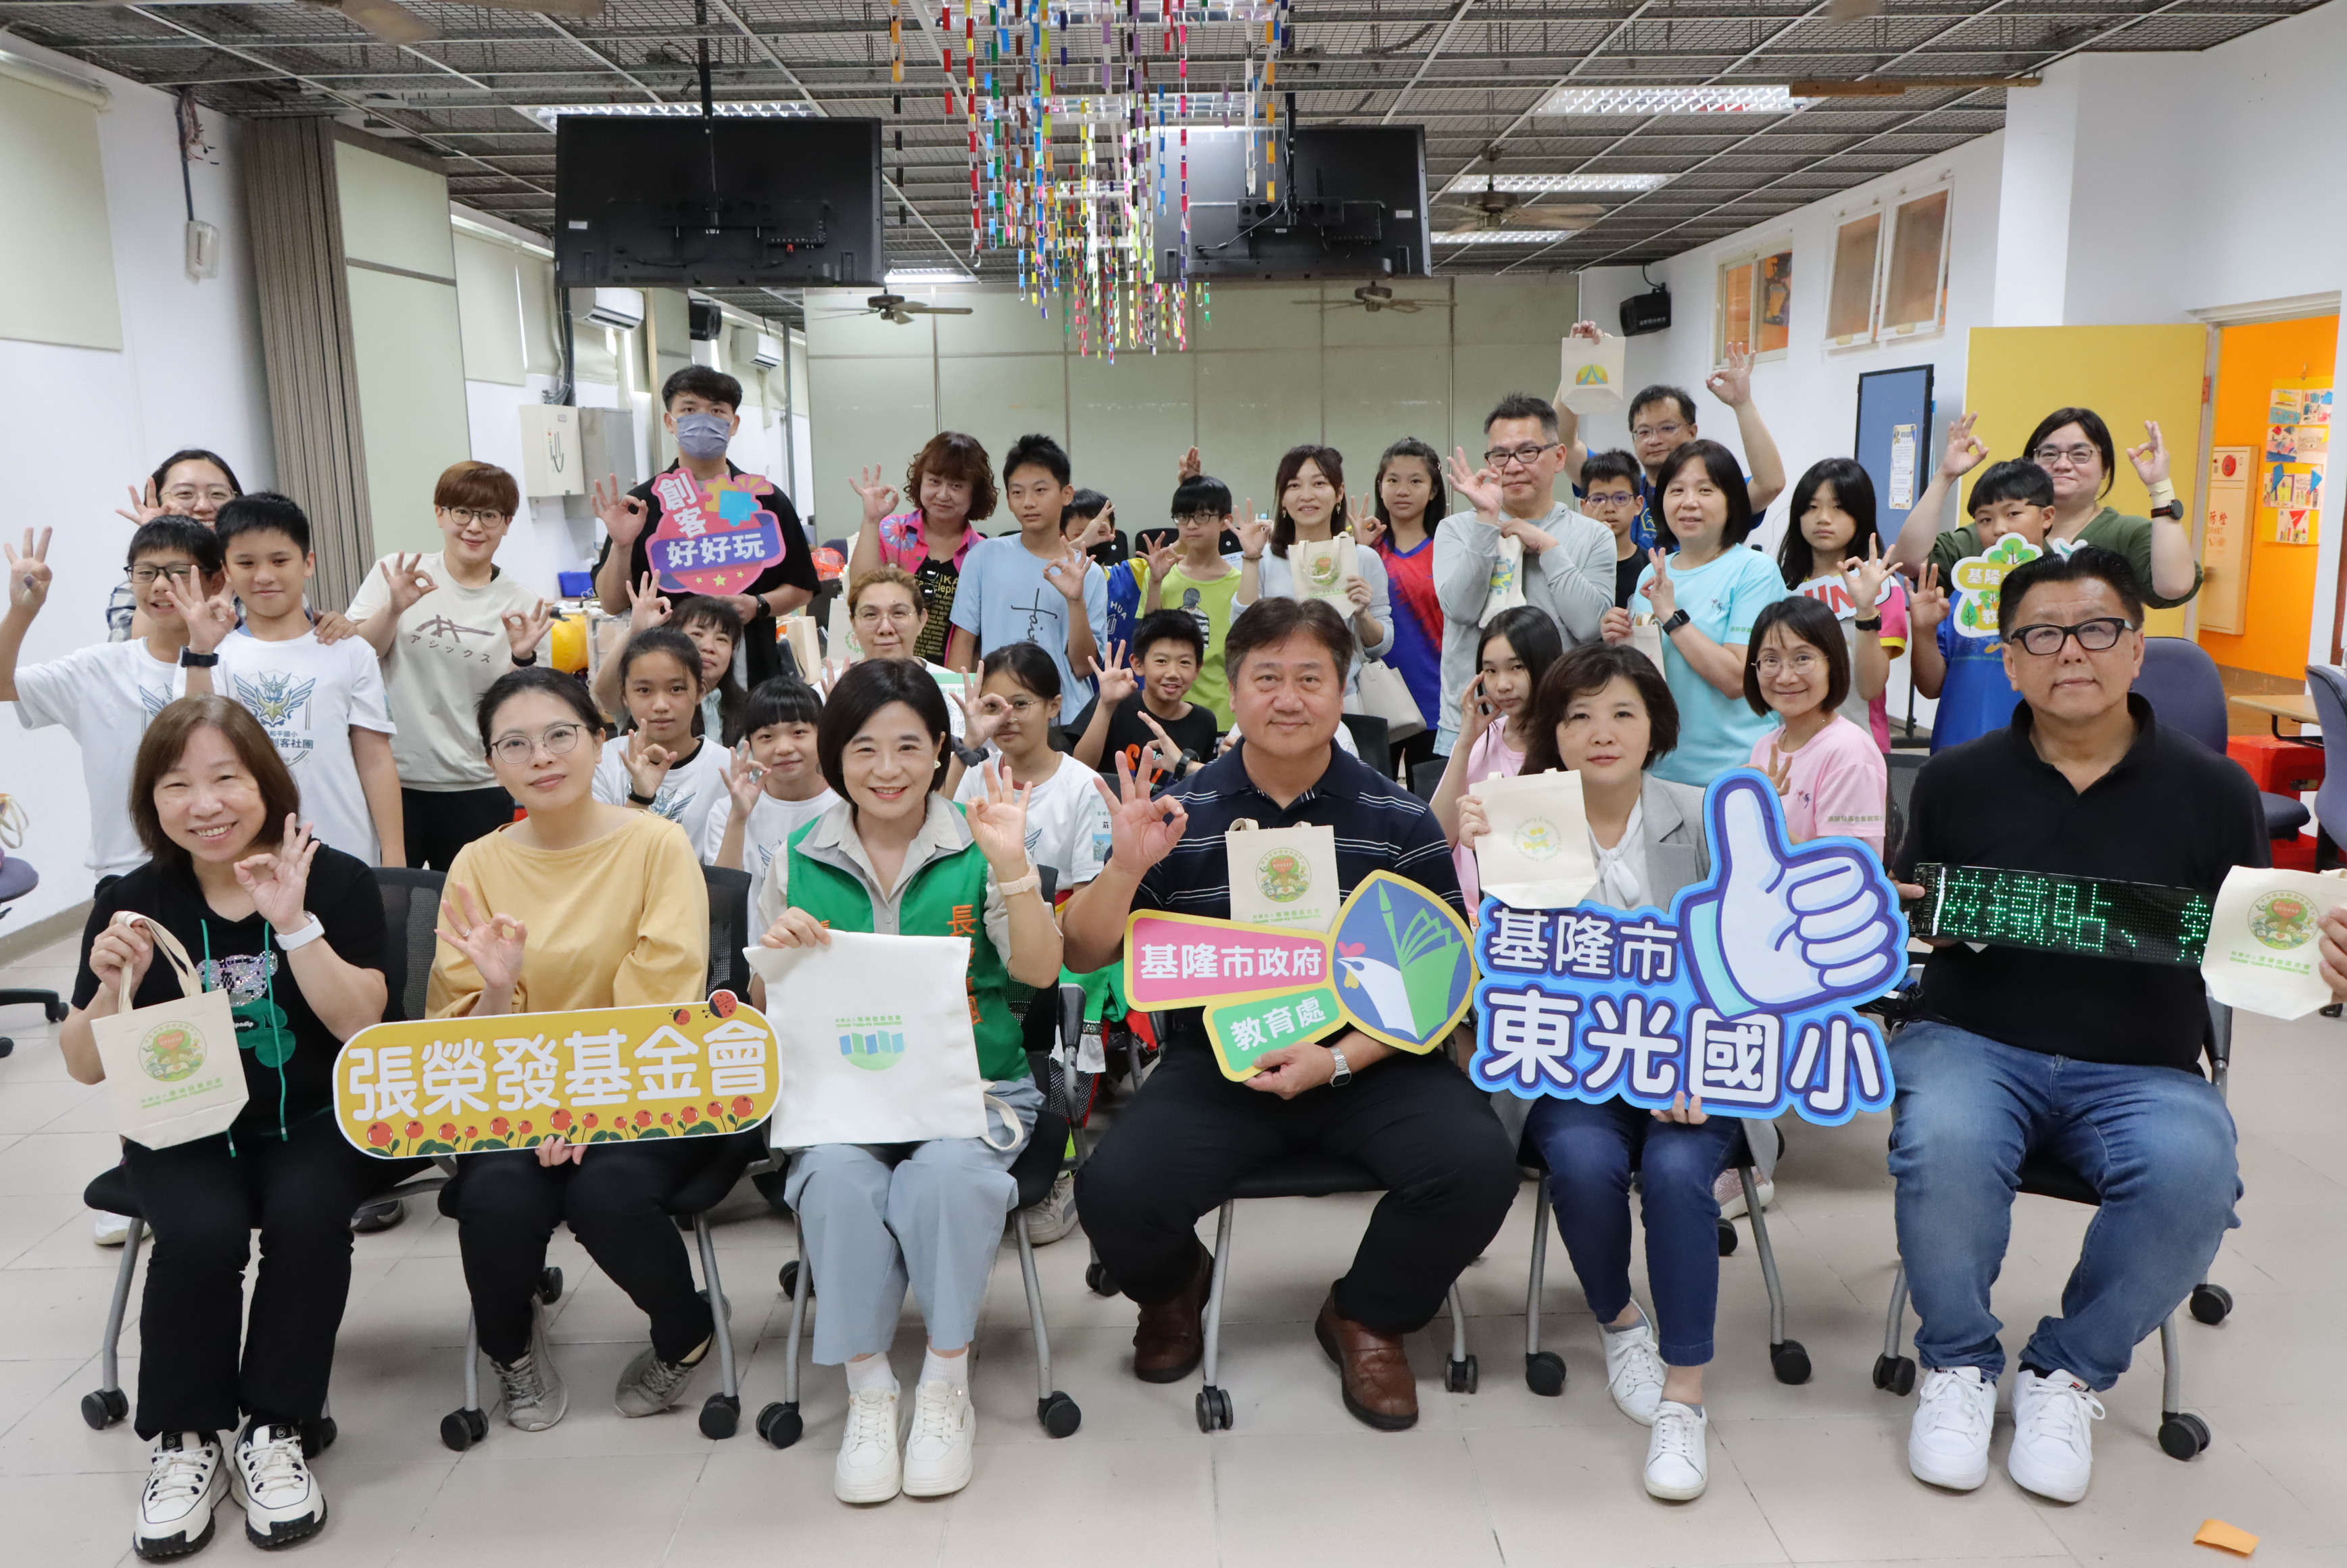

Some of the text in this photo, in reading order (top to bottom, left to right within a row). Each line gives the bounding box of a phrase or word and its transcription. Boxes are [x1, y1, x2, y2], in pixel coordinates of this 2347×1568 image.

[658, 472, 706, 538] 創客
[667, 533, 765, 568] 好好玩
[1111, 601, 1127, 620] HUA
[411, 635, 491, 663] アシックス
[1140, 943, 1323, 979] 基隆市政府
[1489, 908, 1678, 981] 基隆市
[1230, 996, 1327, 1052] 教育處
[1485, 989, 1881, 1110] 東光國小
[348, 1019, 769, 1122] 張榮發基金會
